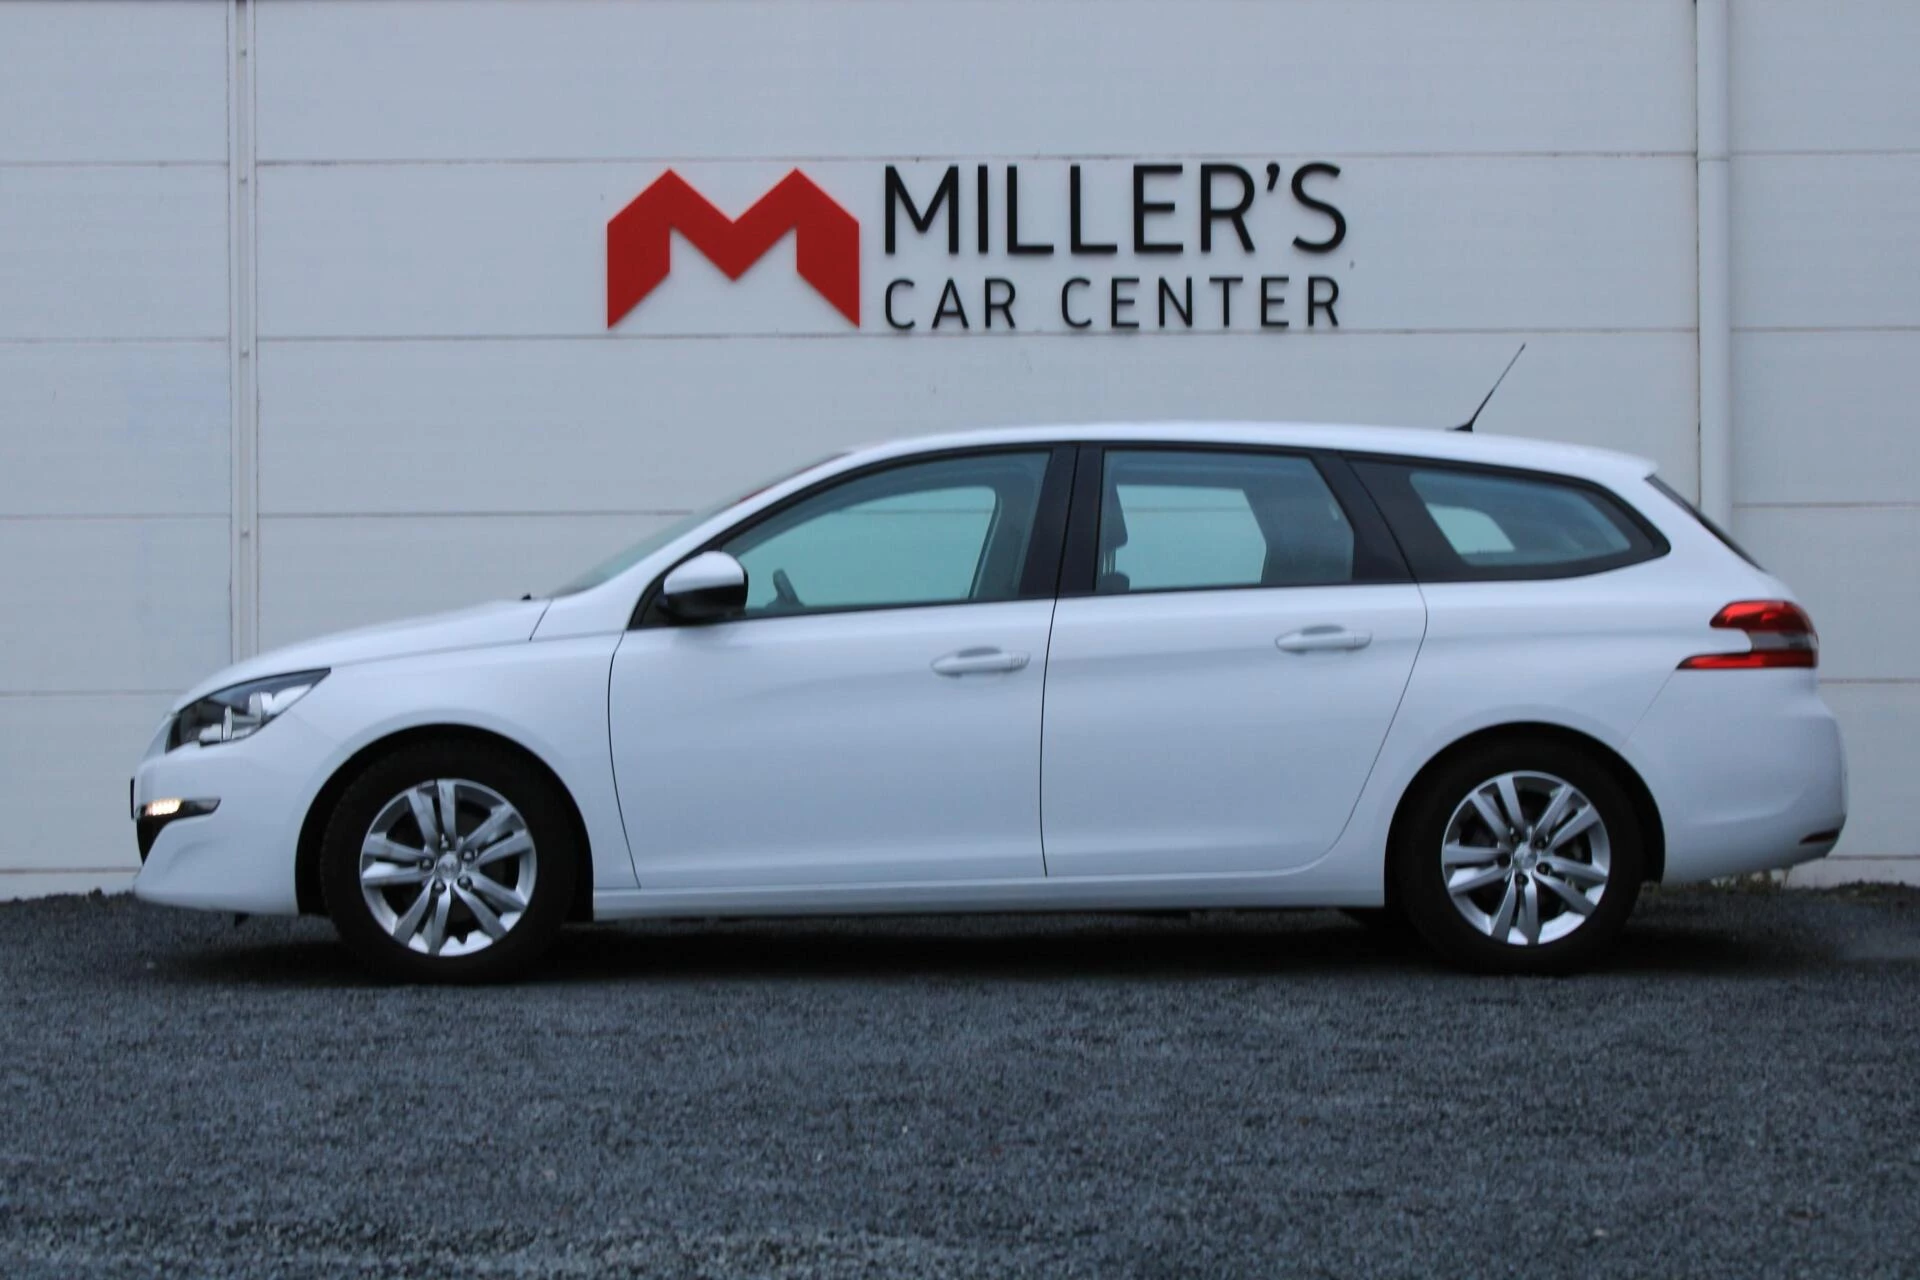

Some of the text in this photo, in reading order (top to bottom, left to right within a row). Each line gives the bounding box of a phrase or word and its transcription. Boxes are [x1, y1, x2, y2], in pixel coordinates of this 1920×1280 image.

[884, 161, 1348, 257] MILLER’S
[884, 275, 1341, 332] CAR CENTER
